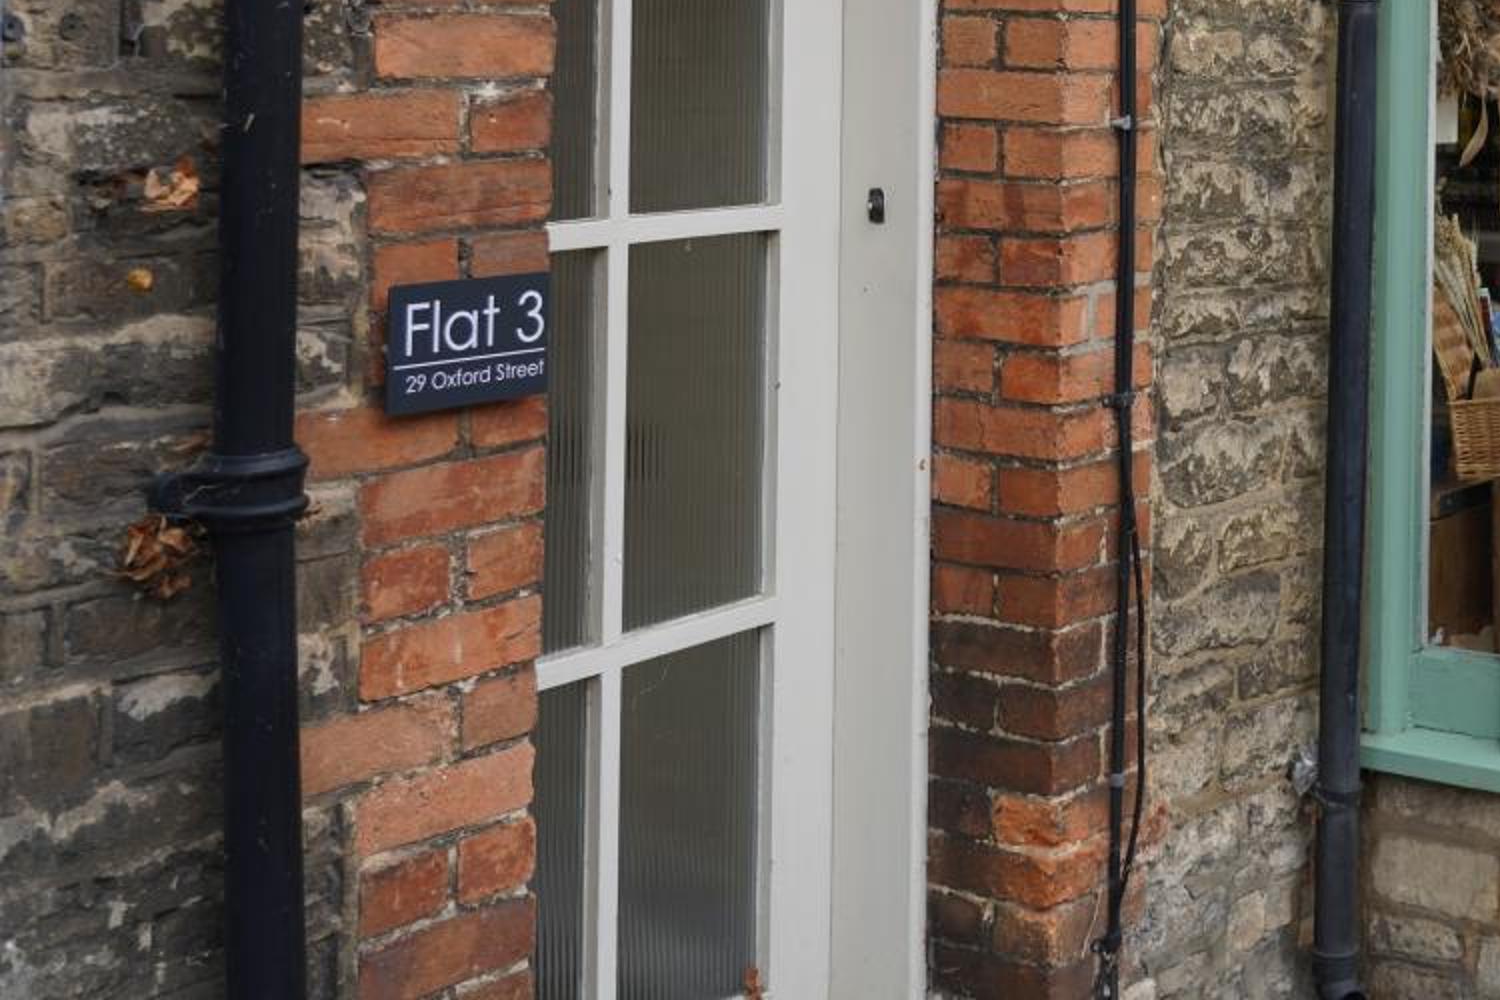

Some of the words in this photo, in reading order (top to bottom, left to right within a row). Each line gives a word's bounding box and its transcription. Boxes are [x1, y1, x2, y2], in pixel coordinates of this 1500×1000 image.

[405, 294, 501, 357] Flat
[516, 289, 545, 343] 3
[404, 374, 427, 394] 29
[431, 365, 491, 389] Oxford
[496, 359, 545, 382] Street
